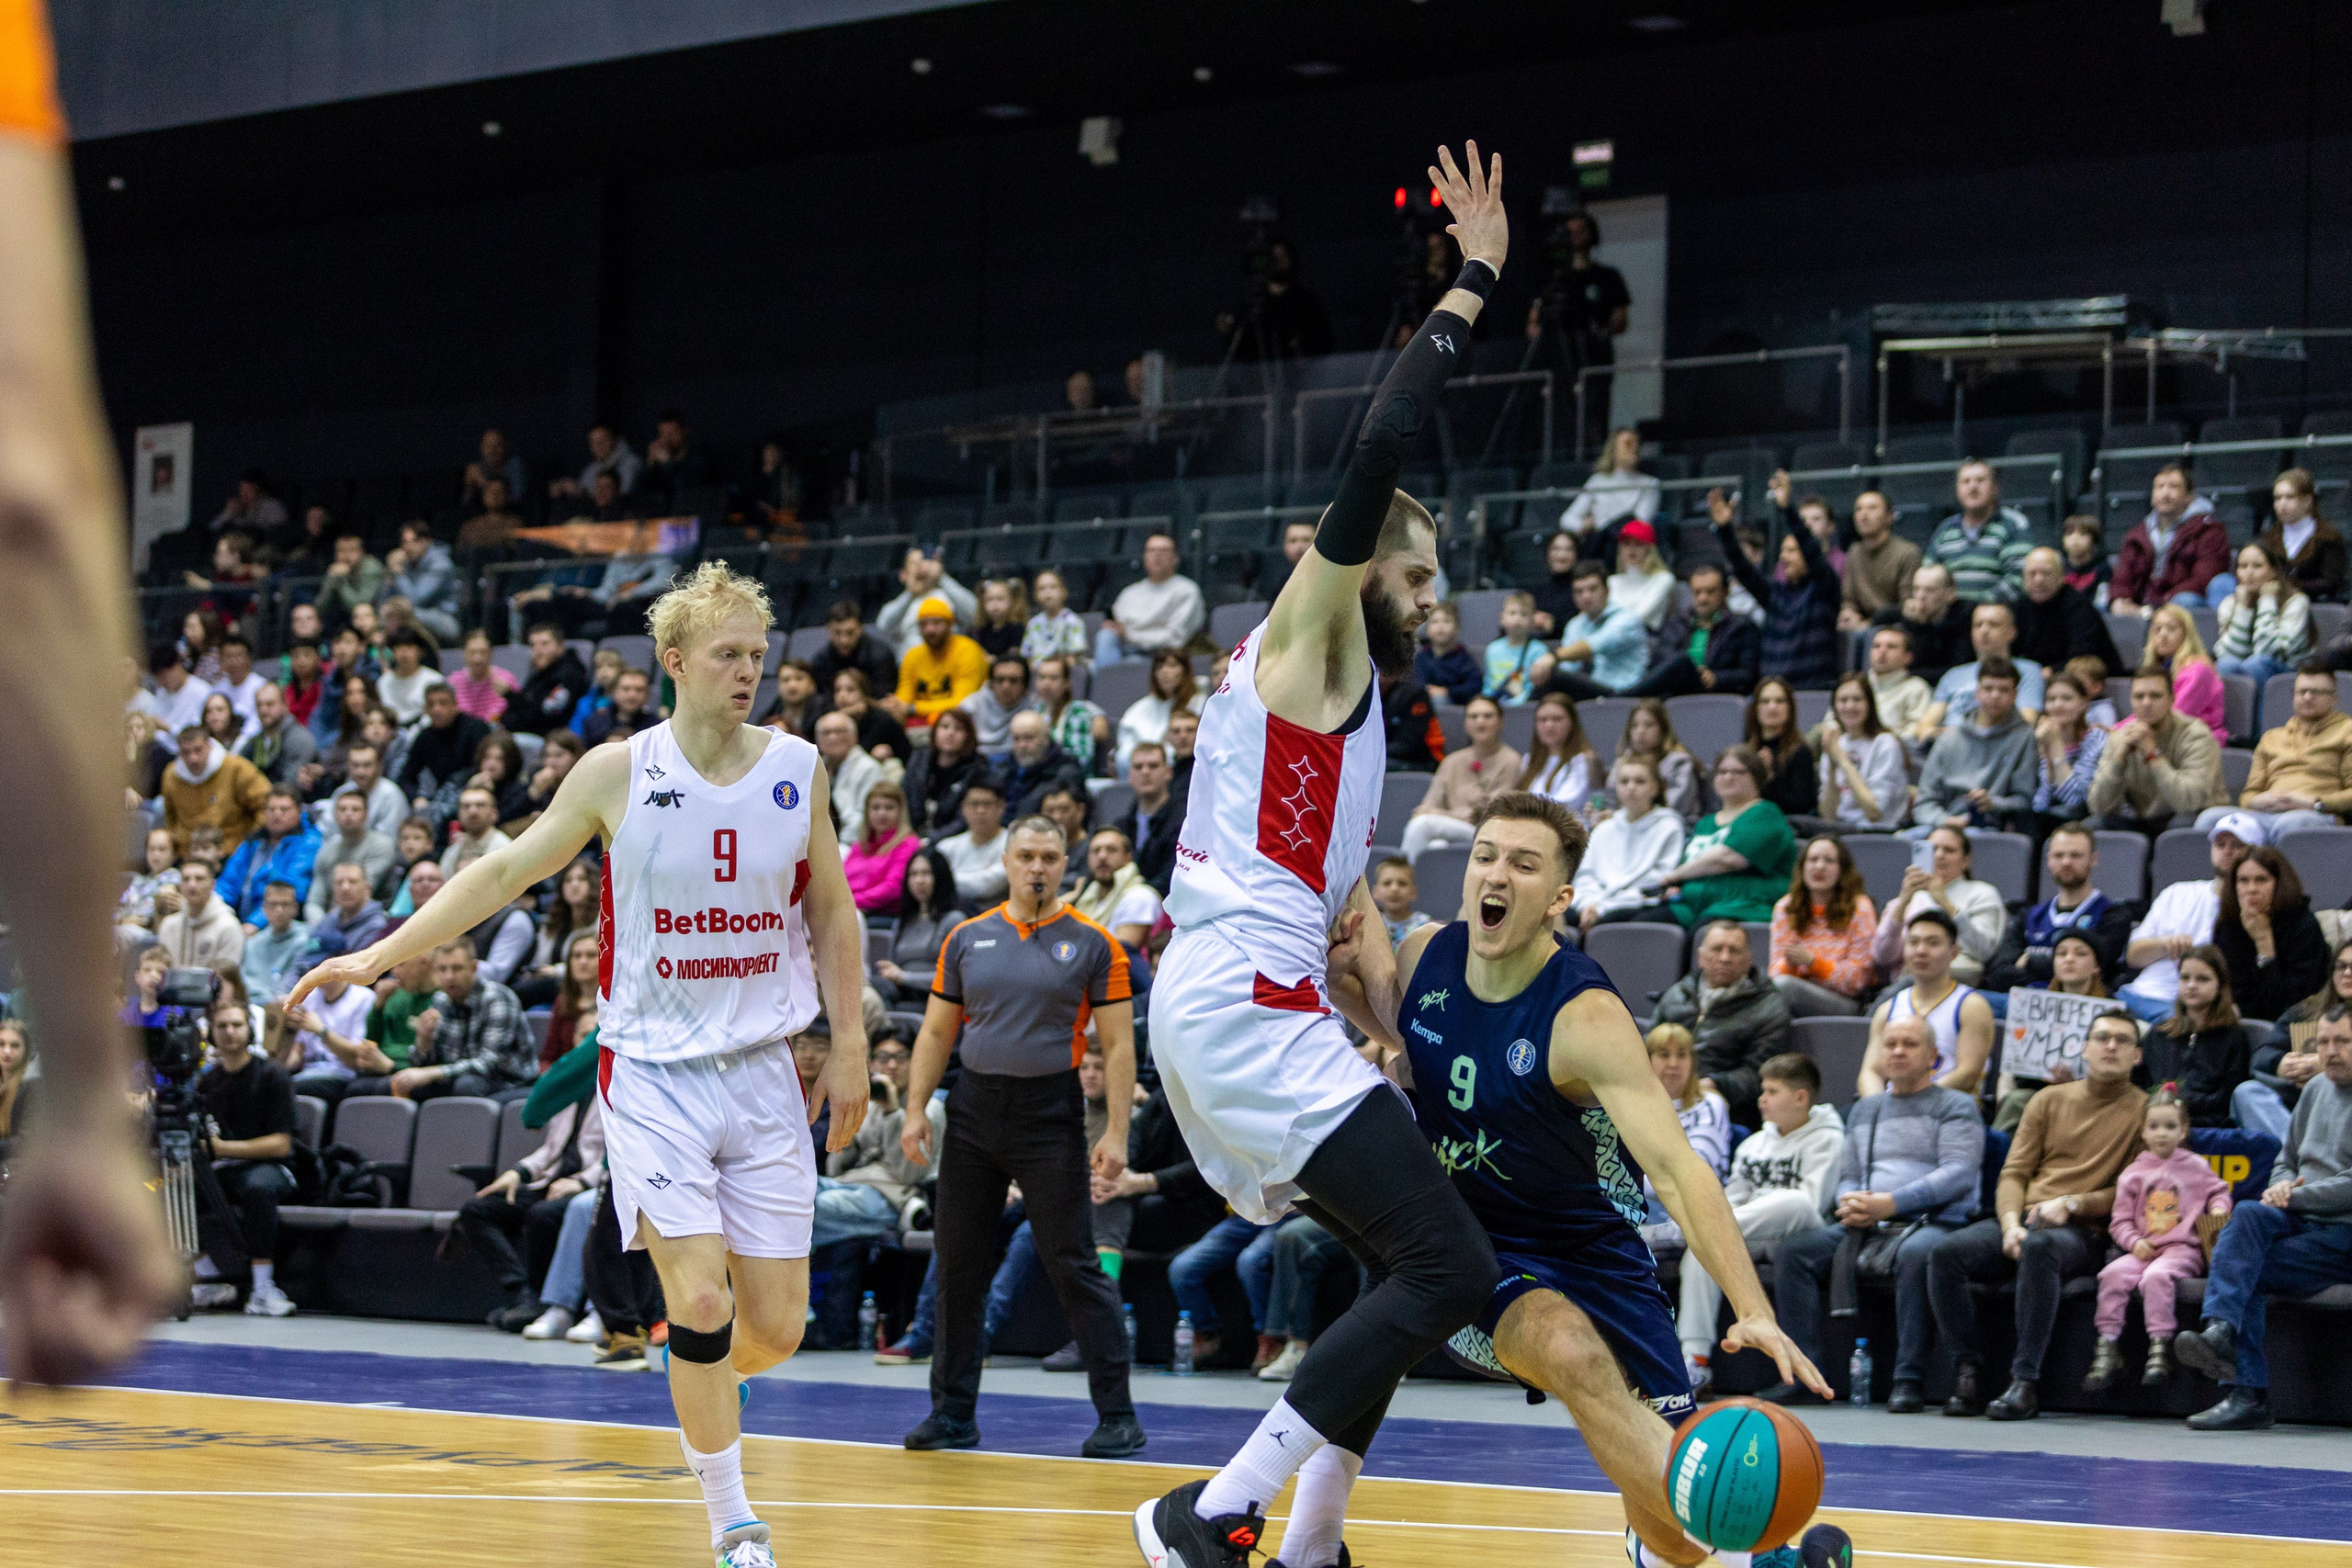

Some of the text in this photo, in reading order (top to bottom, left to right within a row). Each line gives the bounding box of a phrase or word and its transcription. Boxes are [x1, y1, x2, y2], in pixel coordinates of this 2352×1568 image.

[713, 829, 737, 883] 9
[654, 908, 784, 935] BetBoom
[1410, 1018, 1443, 1045] Kempa
[1447, 1055, 1477, 1111] 9
[1675, 1437, 1709, 1524] SIBUR
